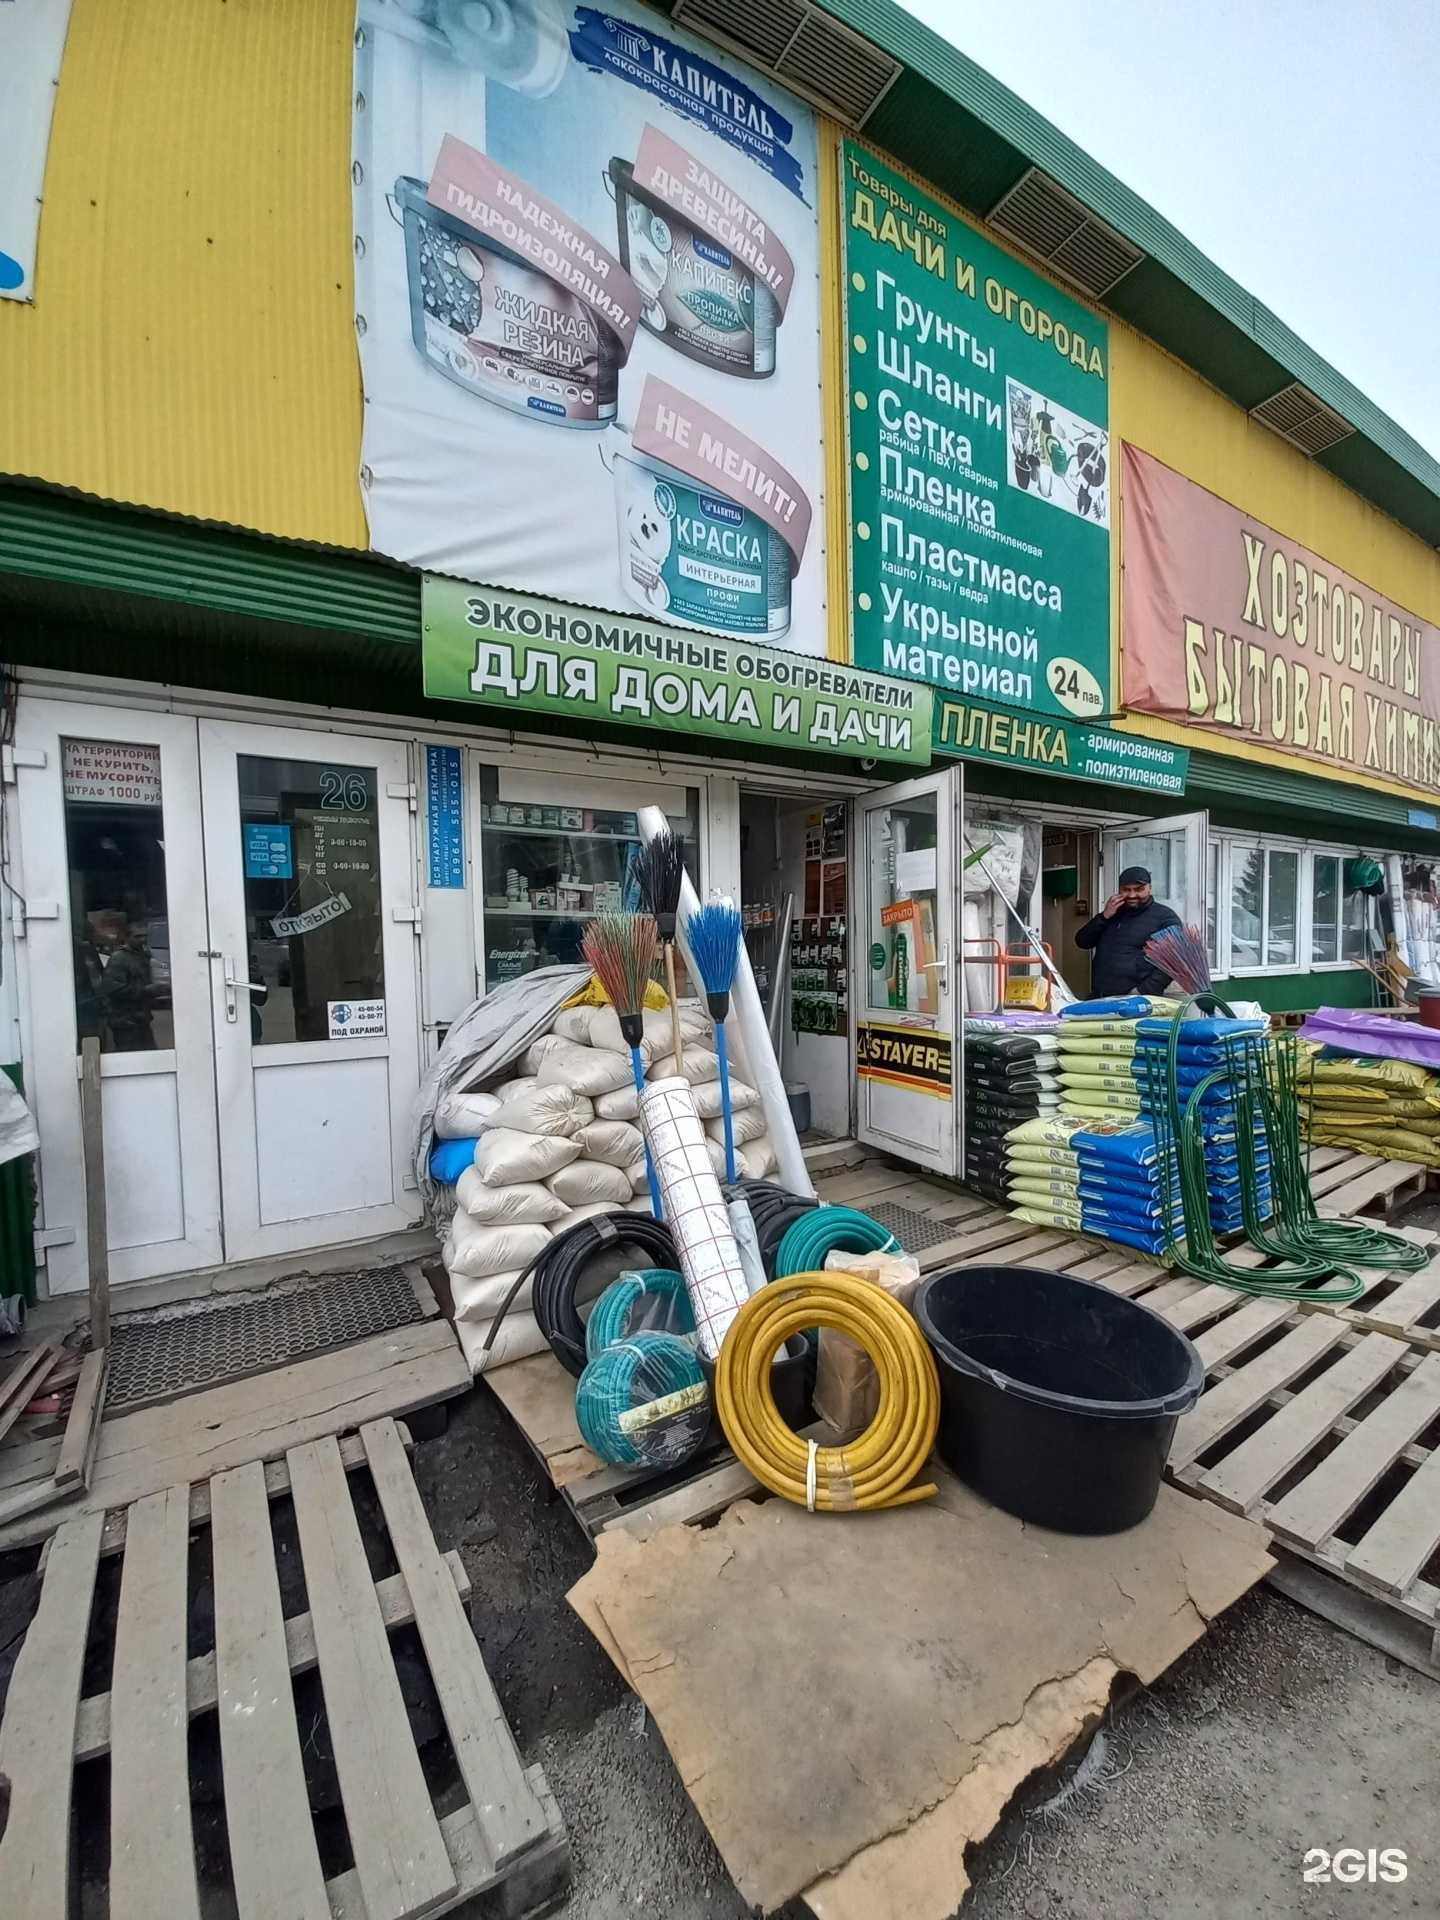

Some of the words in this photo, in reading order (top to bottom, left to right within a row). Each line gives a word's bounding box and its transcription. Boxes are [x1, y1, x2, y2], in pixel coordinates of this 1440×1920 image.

[604, 52, 705, 116] лакокрасочная
[711, 113, 774, 157] продукция
[653, 46, 774, 140] КАПИТЕЛЬ
[651, 165, 783, 289] ДРЕВЕСИНЫ!
[686, 159, 766, 245] ЗАЩИТА
[849, 158, 913, 216] Товары
[917, 209, 947, 238] для
[447, 183, 631, 329] ГИДРОИЗОЛЯЦИЯ!
[496, 180, 610, 279] НАДЕЖНАЯ
[671, 250, 753, 304] КАПИТЕКС
[852, 190, 946, 280] ДАЧИ
[956, 256, 976, 299] И
[984, 276, 1104, 380] ОГОРОДА
[495, 286, 589, 342] ЖИДКАЯ
[687, 292, 740, 324] ПРОПИТКА
[876, 270, 995, 374] Грунты
[504, 320, 584, 366] РЕЗИНА
[877, 329, 1002, 431] Шланги
[878, 388, 972, 466] Сетка
[655, 404, 691, 448] НЕ
[698, 432, 797, 523] МЕЛИТ!
[880, 429, 920, 456] рабица
[928, 449, 951, 469] ПВХ
[959, 466, 999, 490] сварная
[880, 444, 996, 528] Пленка
[676, 514, 762, 563] КРАСКА
[880, 485, 960, 526] армированная
[967, 520, 1043, 559] полиэтиленовая
[686, 563, 756, 589] ИНТЕРЬЕРНАЯ
[881, 513, 1062, 612] Пластмасса
[881, 560, 917, 581] кашпо
[926, 575, 951, 592] тазы
[959, 586, 989, 604] ведра
[706, 588, 740, 602] ПРОФИ
[880, 582, 1038, 662] Укрывной
[1241, 529, 1422, 701] ХОЗТОВАРЫ
[467, 599, 728, 673] ЭКОНОМИЧНЫЕ
[736, 654, 913, 709] ОБОГРЕВАТЕЛИ
[882, 639, 1032, 700] материал
[469, 640, 597, 702] ДЛЯ
[611, 665, 761, 729] ДОМА
[772, 693, 801, 735] И
[809, 701, 912, 752] ДАЧИ
[1054, 665, 1080, 699] 24
[1082, 691, 1103, 706] пав.
[1183, 614, 1355, 763] БЫТОВАЯ
[1364, 692, 1440, 788] ХИМИ
[82, 745, 160, 761] ТЕРРИТОРИИ
[940, 700, 1070, 766] ПЛЕНКА
[1087, 733, 1174, 765] армированная
[64, 769, 85, 779] НЕ
[86, 771, 160, 785] МУСОРИТЬ
[73, 757, 93, 767] НЕ
[94, 759, 154, 773] КУРИТЬ,
[109, 786, 141, 799] 1000
[319, 771, 367, 812] 26
[1085, 759, 1182, 789] полиэтиленовая
[431, 806, 441, 864] НАРУЖНАЯ
[452, 838, 460, 874] 8964
[433, 867, 441, 885] ВСЯ
[489, 949, 530, 961] Energizer
[331, 1028, 348, 1036] ПОД
[350, 1025, 385, 1035] ОХРАНОЙ
[870, 1038, 939, 1071] STAYER
